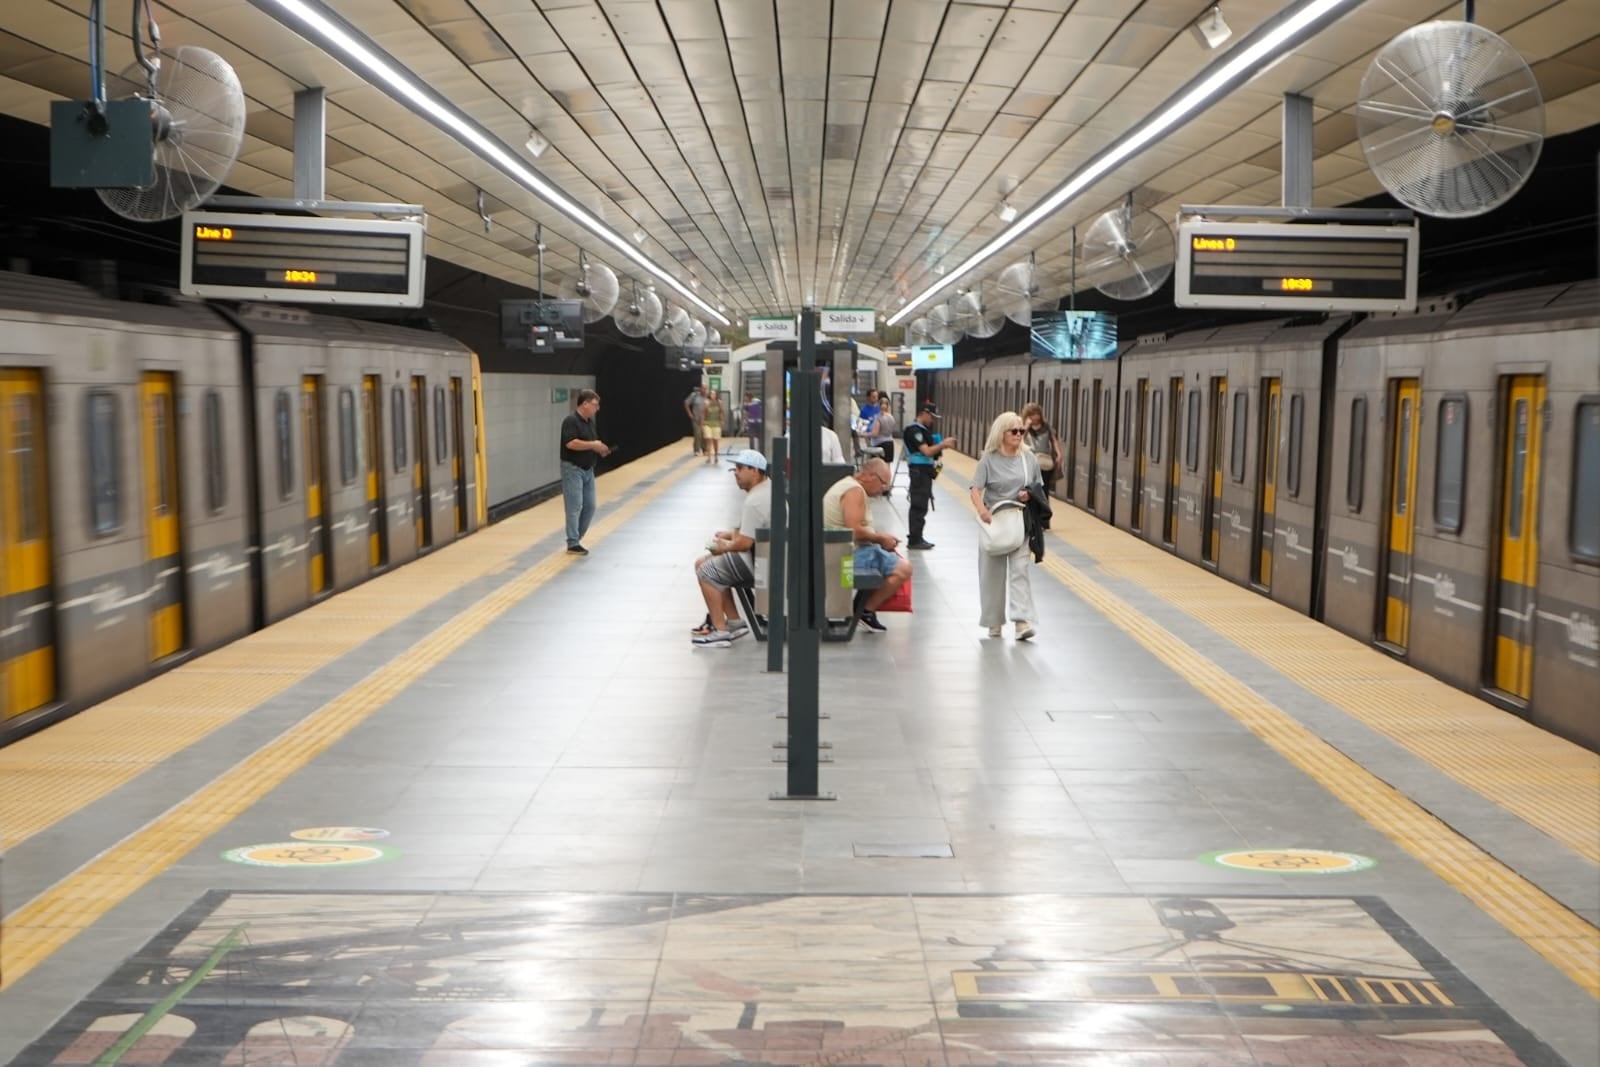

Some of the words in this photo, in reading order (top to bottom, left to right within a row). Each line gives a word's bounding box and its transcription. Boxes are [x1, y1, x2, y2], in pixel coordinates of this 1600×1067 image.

[222, 228, 232, 239] D
[829, 314, 857, 323] Salida
[764, 322, 788, 330] Salida
